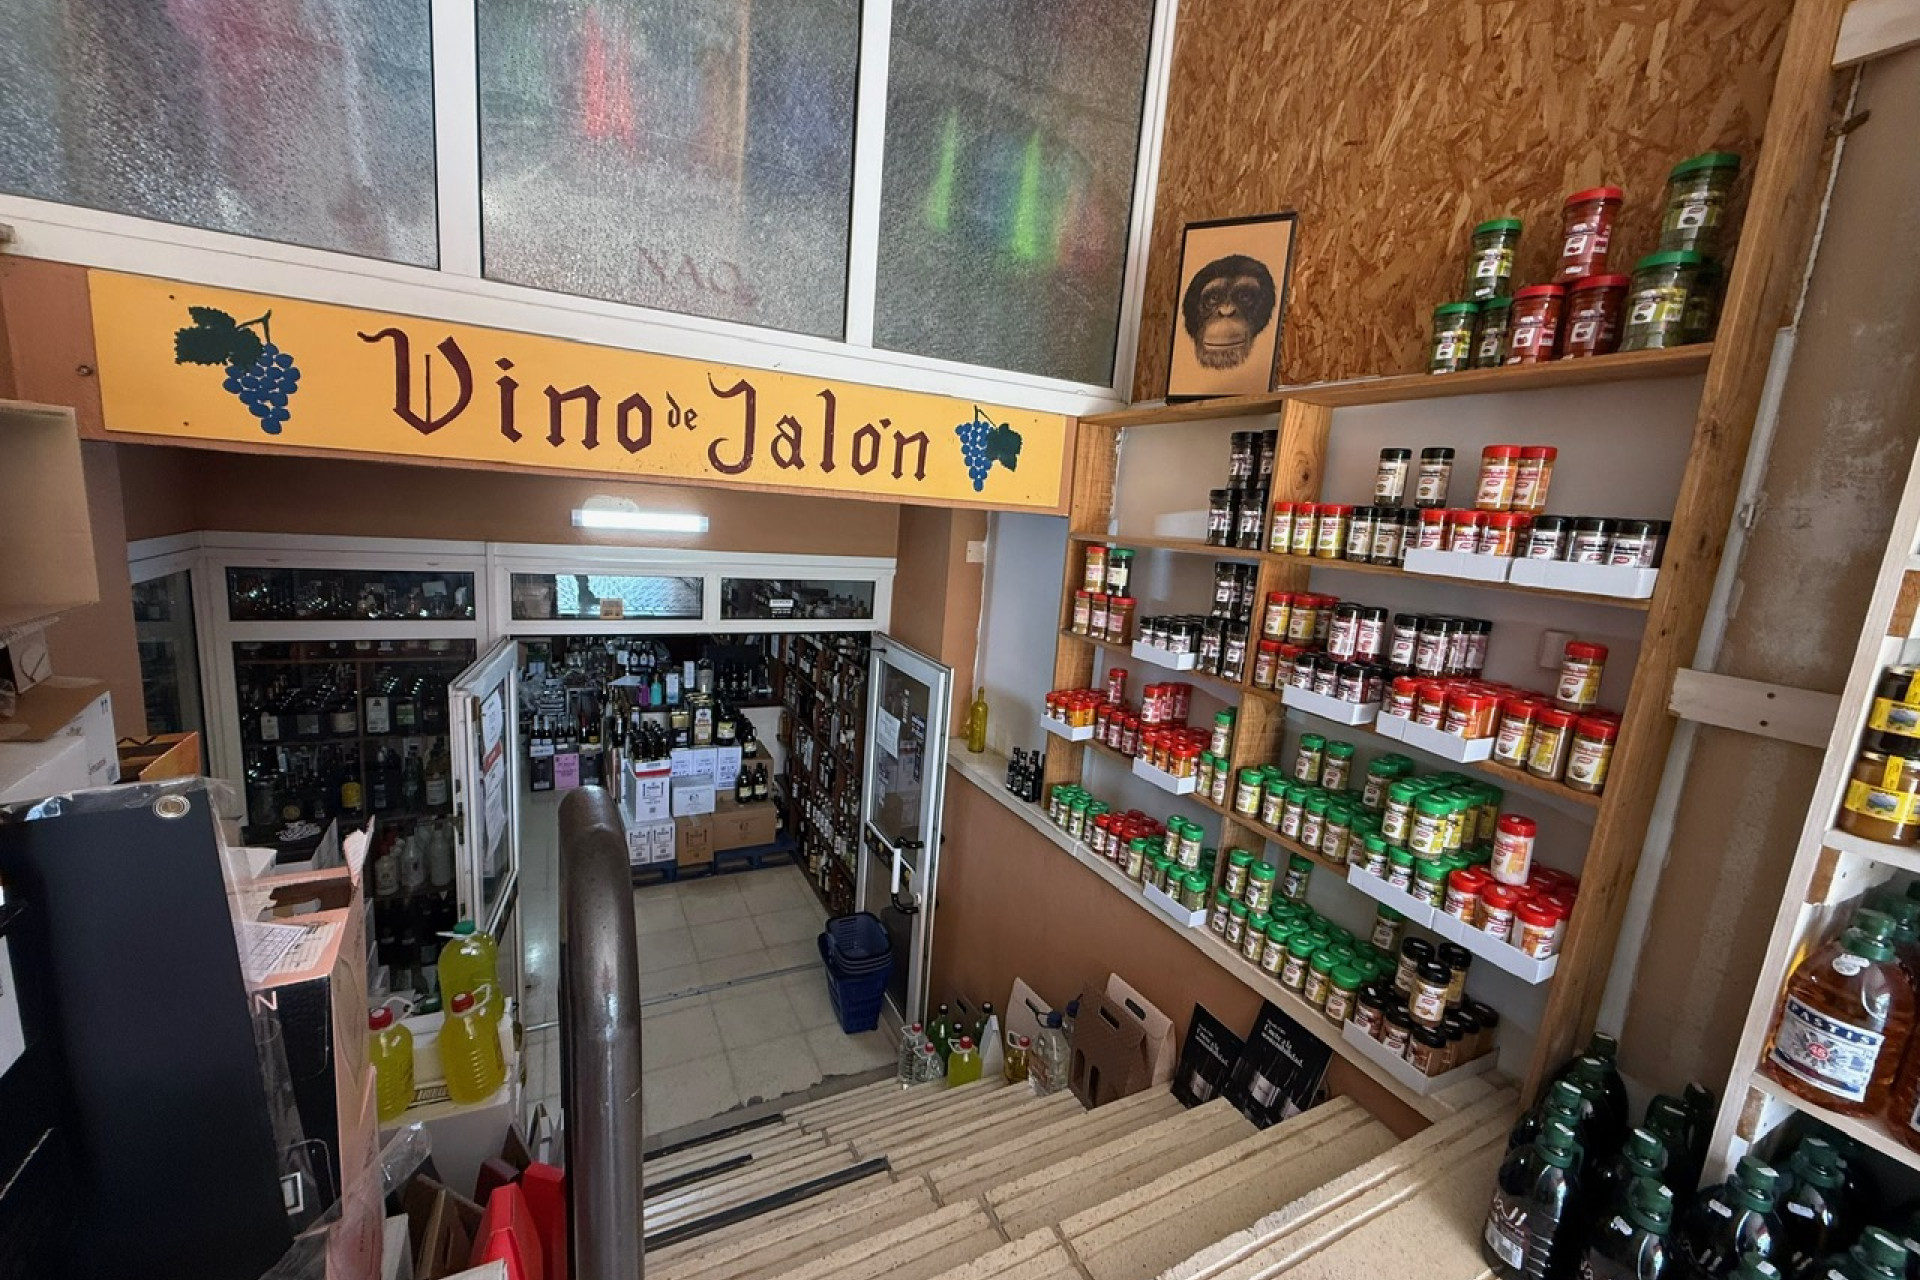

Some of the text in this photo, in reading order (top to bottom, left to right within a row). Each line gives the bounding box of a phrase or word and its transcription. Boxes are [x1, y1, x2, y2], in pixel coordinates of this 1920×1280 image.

[357, 327, 931, 482] Vino de Jalón
[1790, 1001, 1873, 1044] PASTIS
